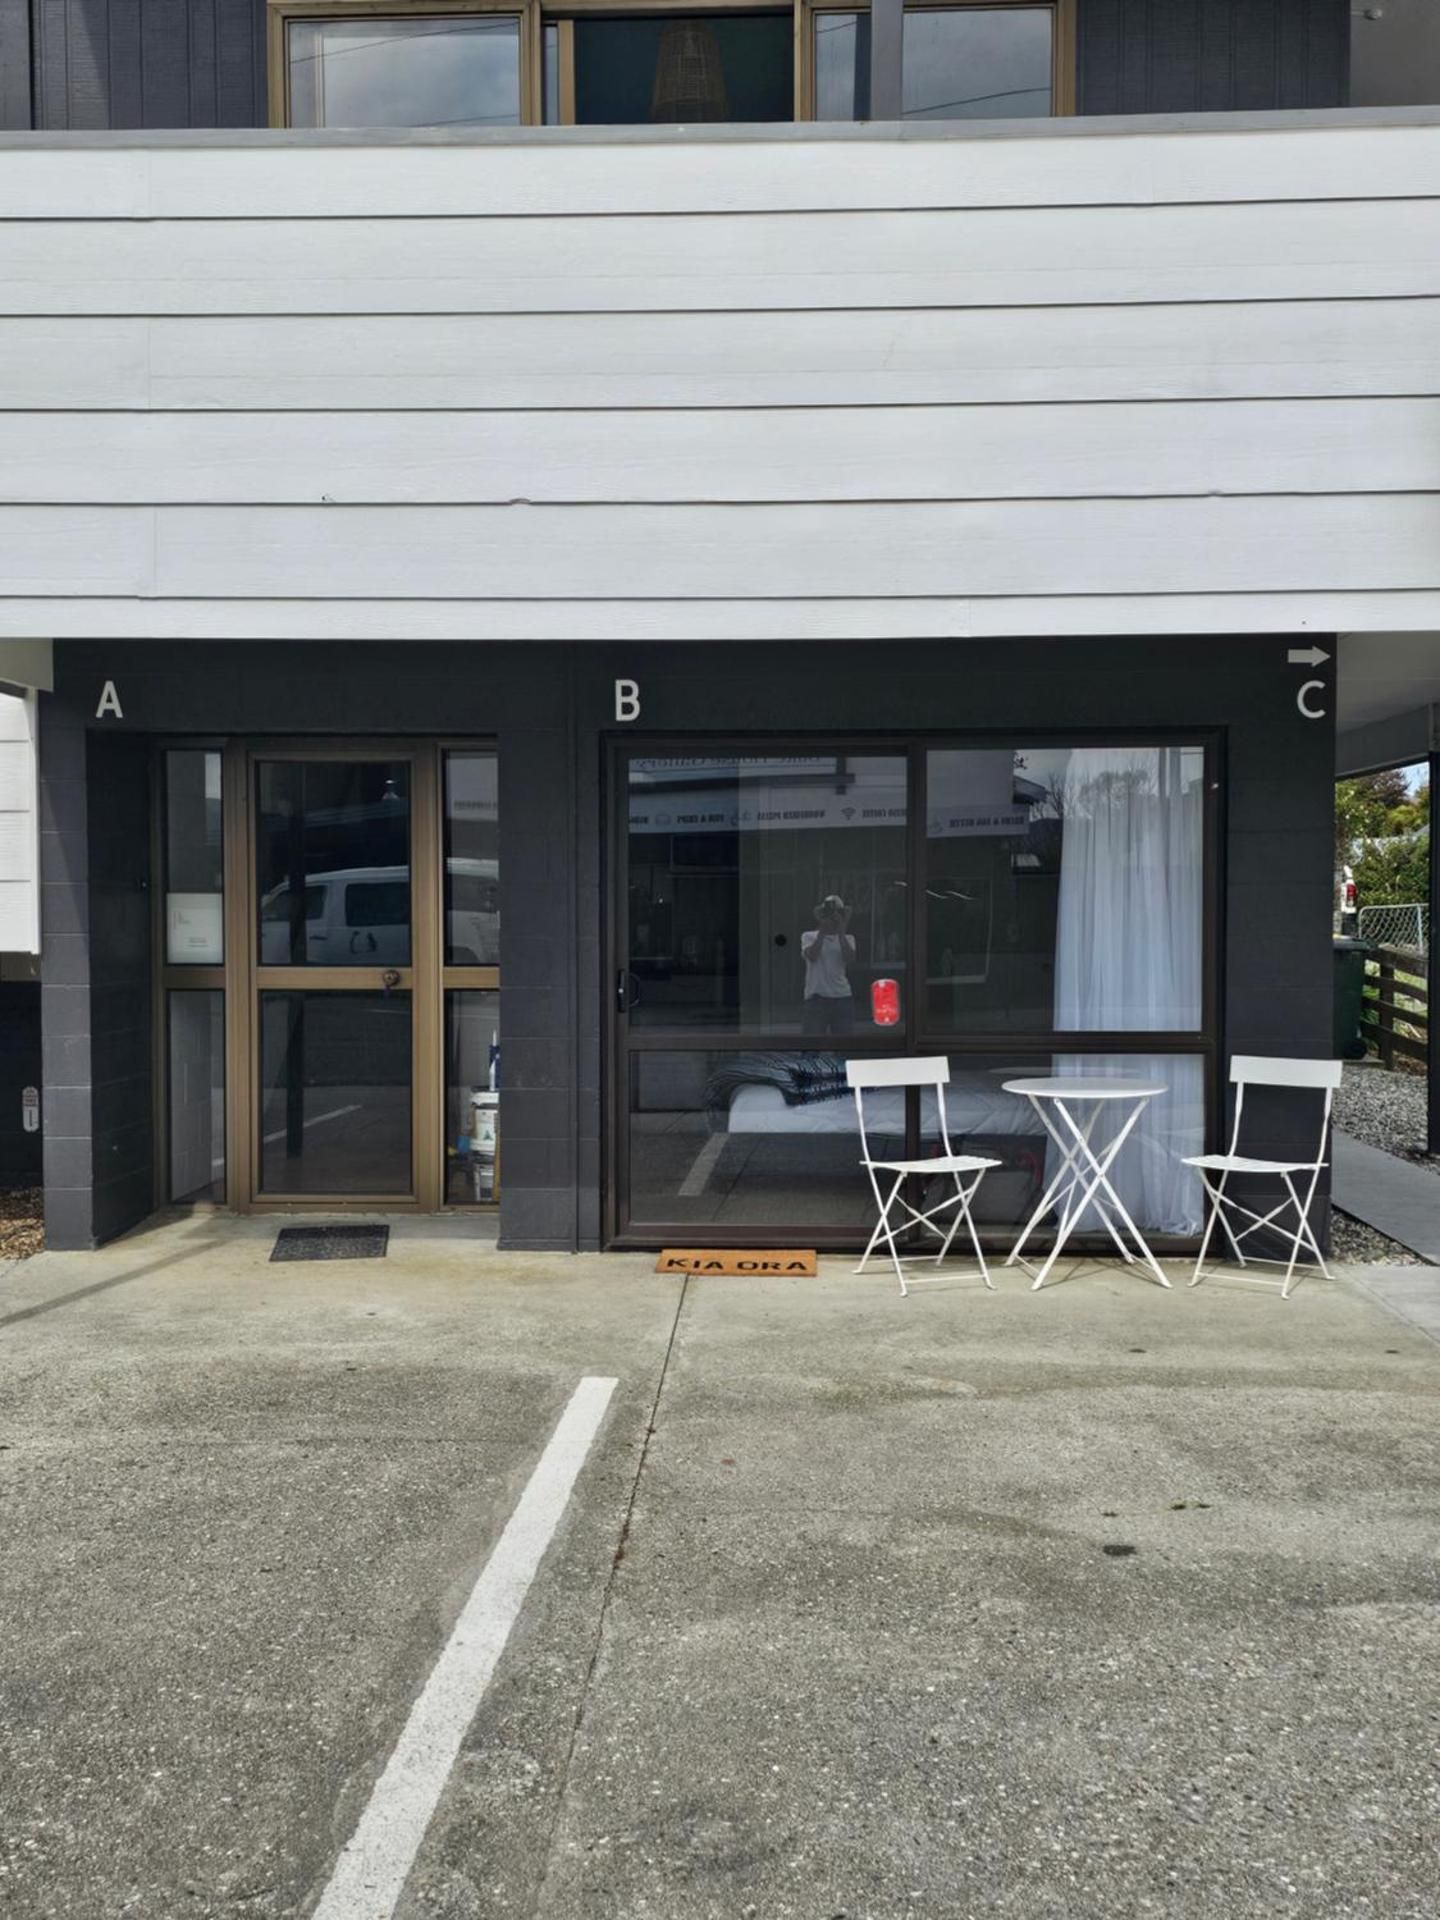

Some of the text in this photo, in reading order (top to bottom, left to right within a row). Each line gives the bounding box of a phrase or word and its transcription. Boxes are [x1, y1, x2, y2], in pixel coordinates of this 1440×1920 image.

[96, 681, 123, 718] A
[615, 679, 640, 722] B
[1297, 680, 1326, 719] C
[667, 1259, 807, 1270] KIA ORA
